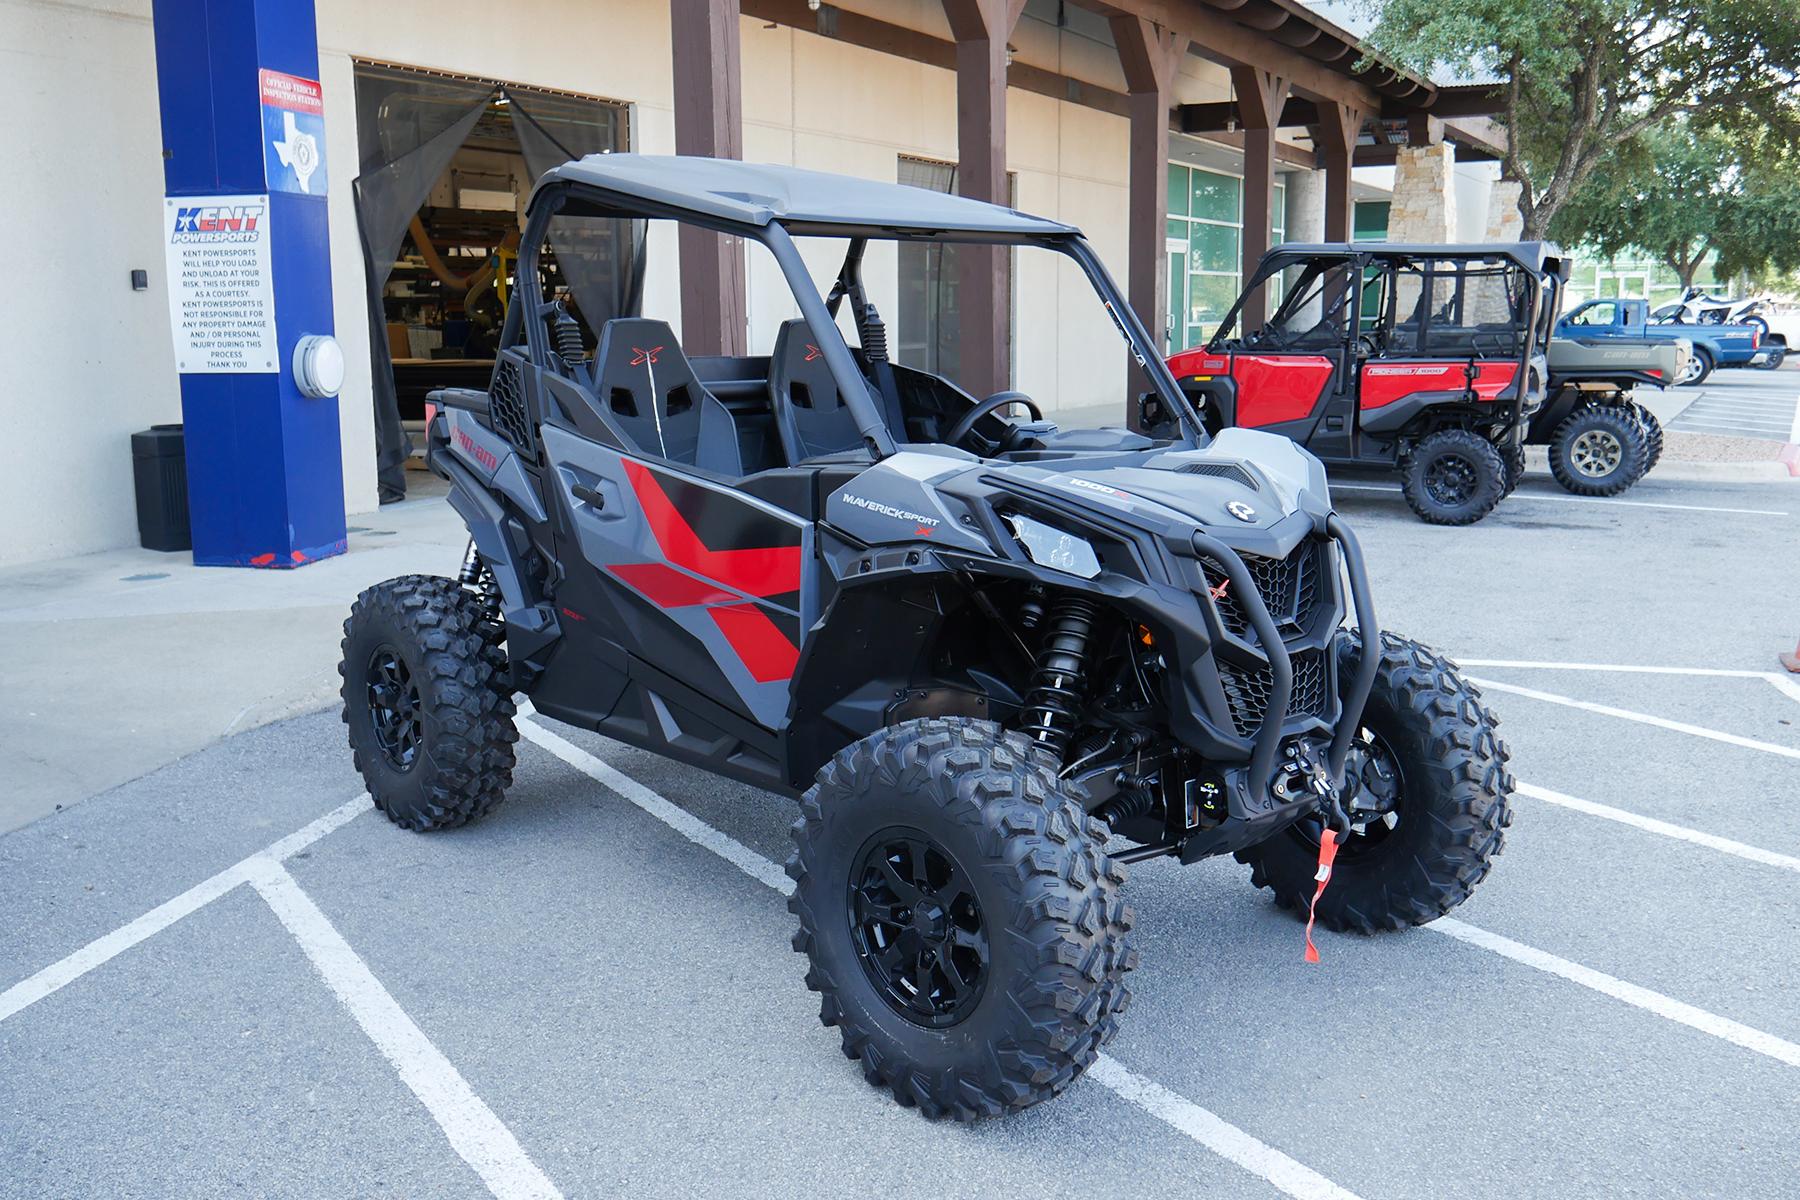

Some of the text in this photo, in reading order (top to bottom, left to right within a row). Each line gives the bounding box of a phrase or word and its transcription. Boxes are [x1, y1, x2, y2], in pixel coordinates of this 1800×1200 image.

[266, 78, 318, 96] OFFICIAL VEHICLE
[263, 87, 322, 106] INSPECTION STATION
[174, 205, 265, 232] KENT
[170, 230, 260, 244] POWERSPORTS
[203, 249, 256, 257] POWERSPORTS
[238, 259, 257, 267] LOAD
[182, 270, 198, 278] AND
[240, 269, 260, 277] YOUR
[182, 280, 201, 288] RISK.
[203, 280, 218, 288] THIS
[212, 290, 251, 298] COURTESY.
[203, 300, 256, 308] POWERSPORTS
[200, 310, 248, 318] RESPONSIBLE
[237, 320, 266, 328] DAMAGE
[1603, 351, 1650, 359] can-am
[450, 425, 498, 471] can-am
